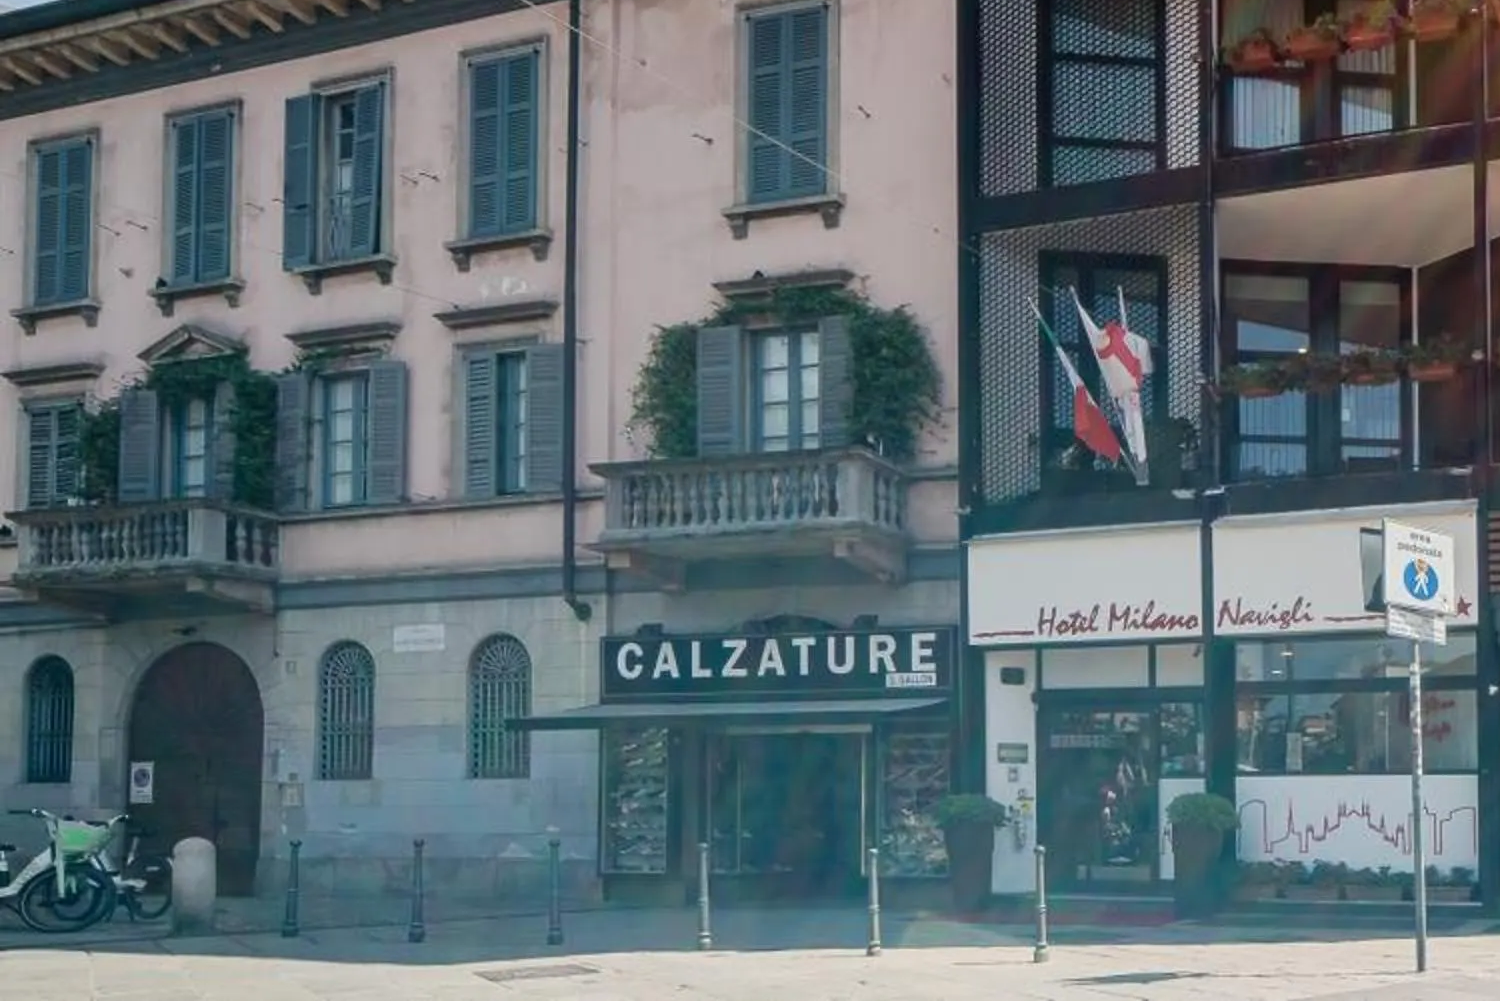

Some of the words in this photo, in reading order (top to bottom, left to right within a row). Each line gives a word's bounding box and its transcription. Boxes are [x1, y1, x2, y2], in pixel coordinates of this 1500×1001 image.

[1037, 603, 1099, 636] Hotel
[1107, 599, 1199, 631] Milano
[1217, 596, 1314, 629] Navigli
[617, 633, 937, 680] CALZATURE
